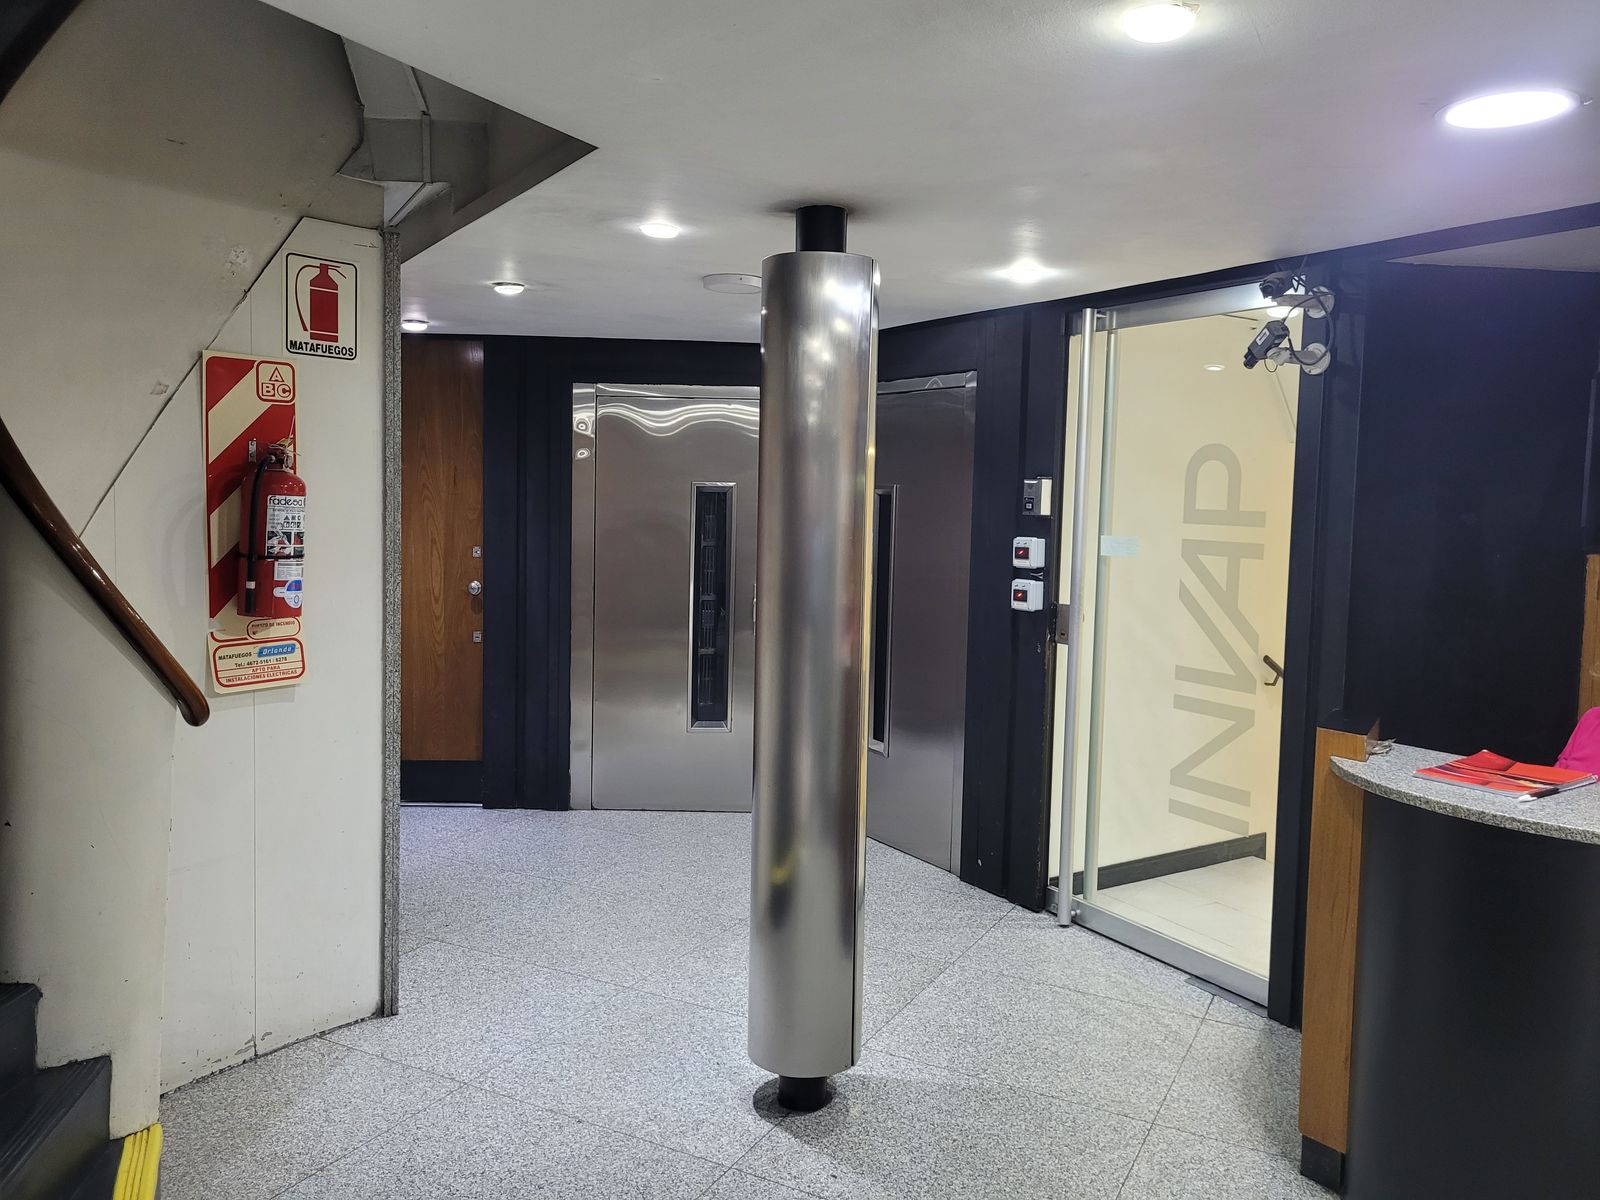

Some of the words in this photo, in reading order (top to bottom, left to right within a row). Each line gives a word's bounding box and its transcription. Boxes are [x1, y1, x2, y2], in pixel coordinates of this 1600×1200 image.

[289, 340, 354, 357] MATAFUEGOS
[1168, 443, 1266, 837] INVAP
[218, 651, 252, 660] MATAFUEGOS
[262, 646, 292, 655] Orlando
[225, 673, 266, 683] INSTALACIONES
